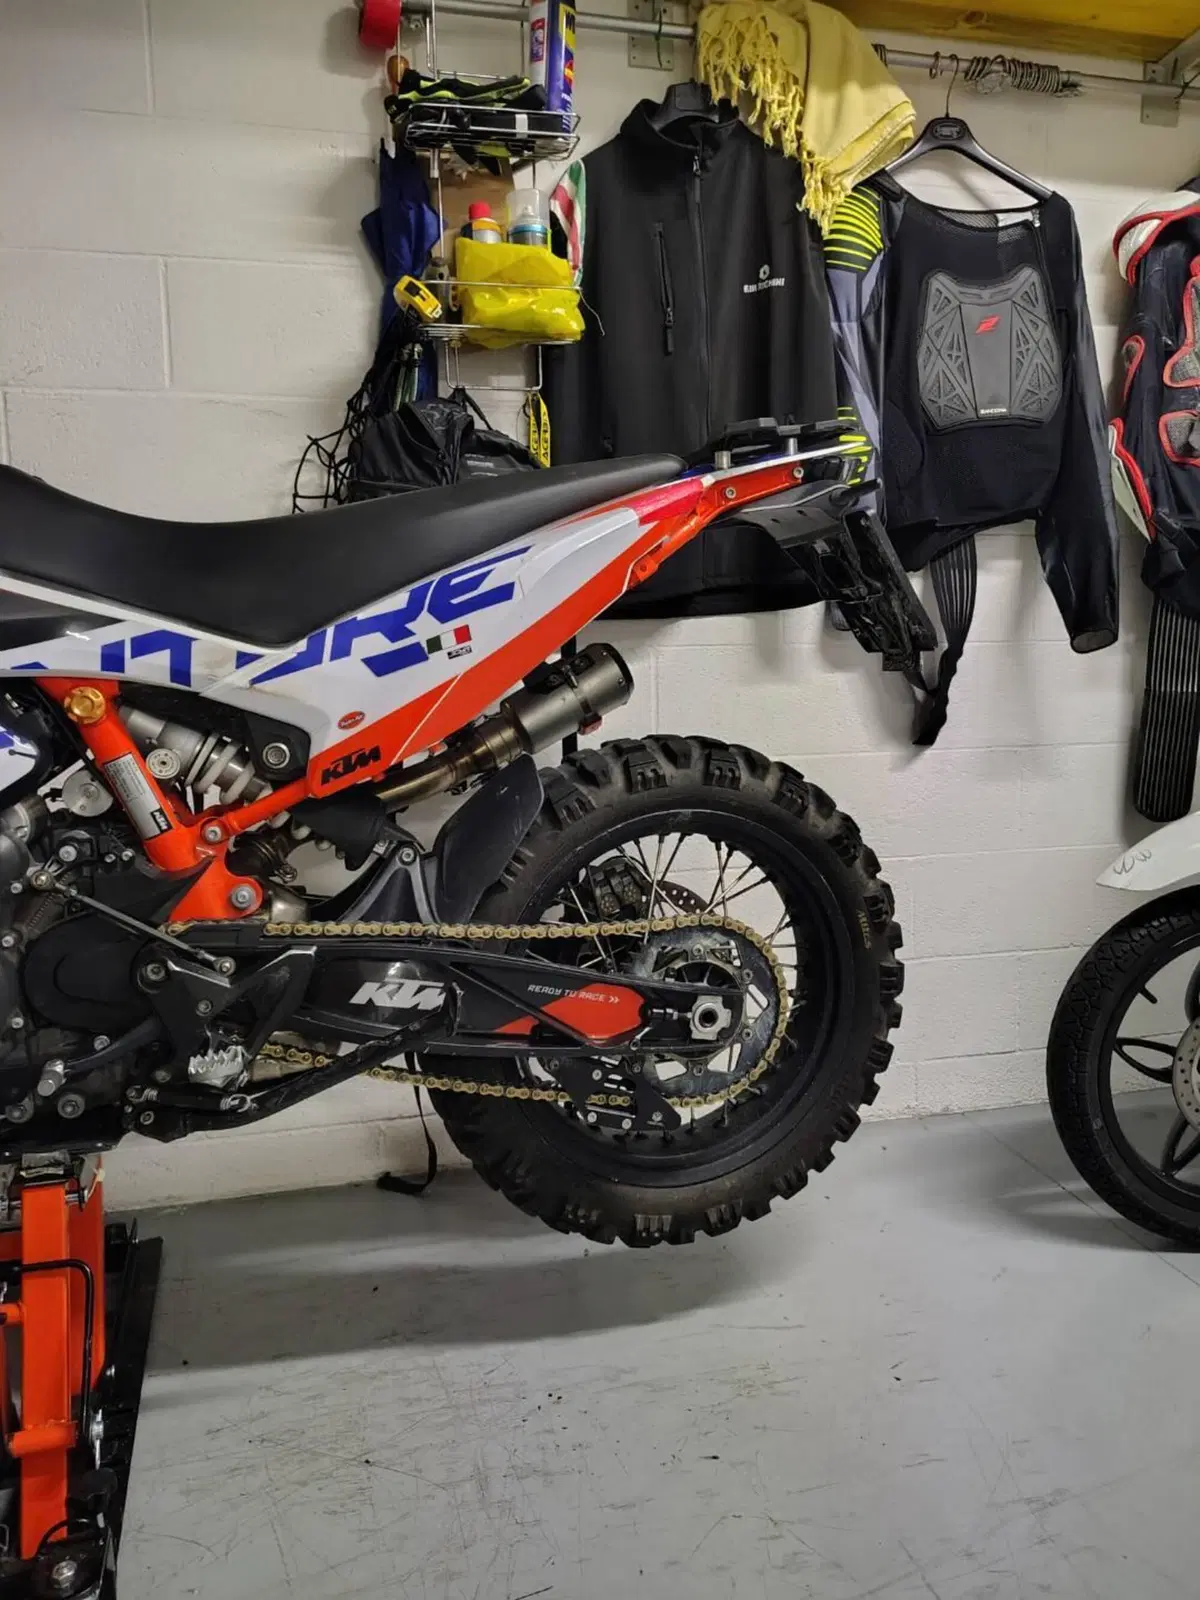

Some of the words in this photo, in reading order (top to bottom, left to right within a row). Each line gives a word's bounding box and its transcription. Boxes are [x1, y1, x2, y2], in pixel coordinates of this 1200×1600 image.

[320, 745, 381, 785] KTM
[527, 984, 562, 996] READY
[578, 991, 606, 1002] RACE
